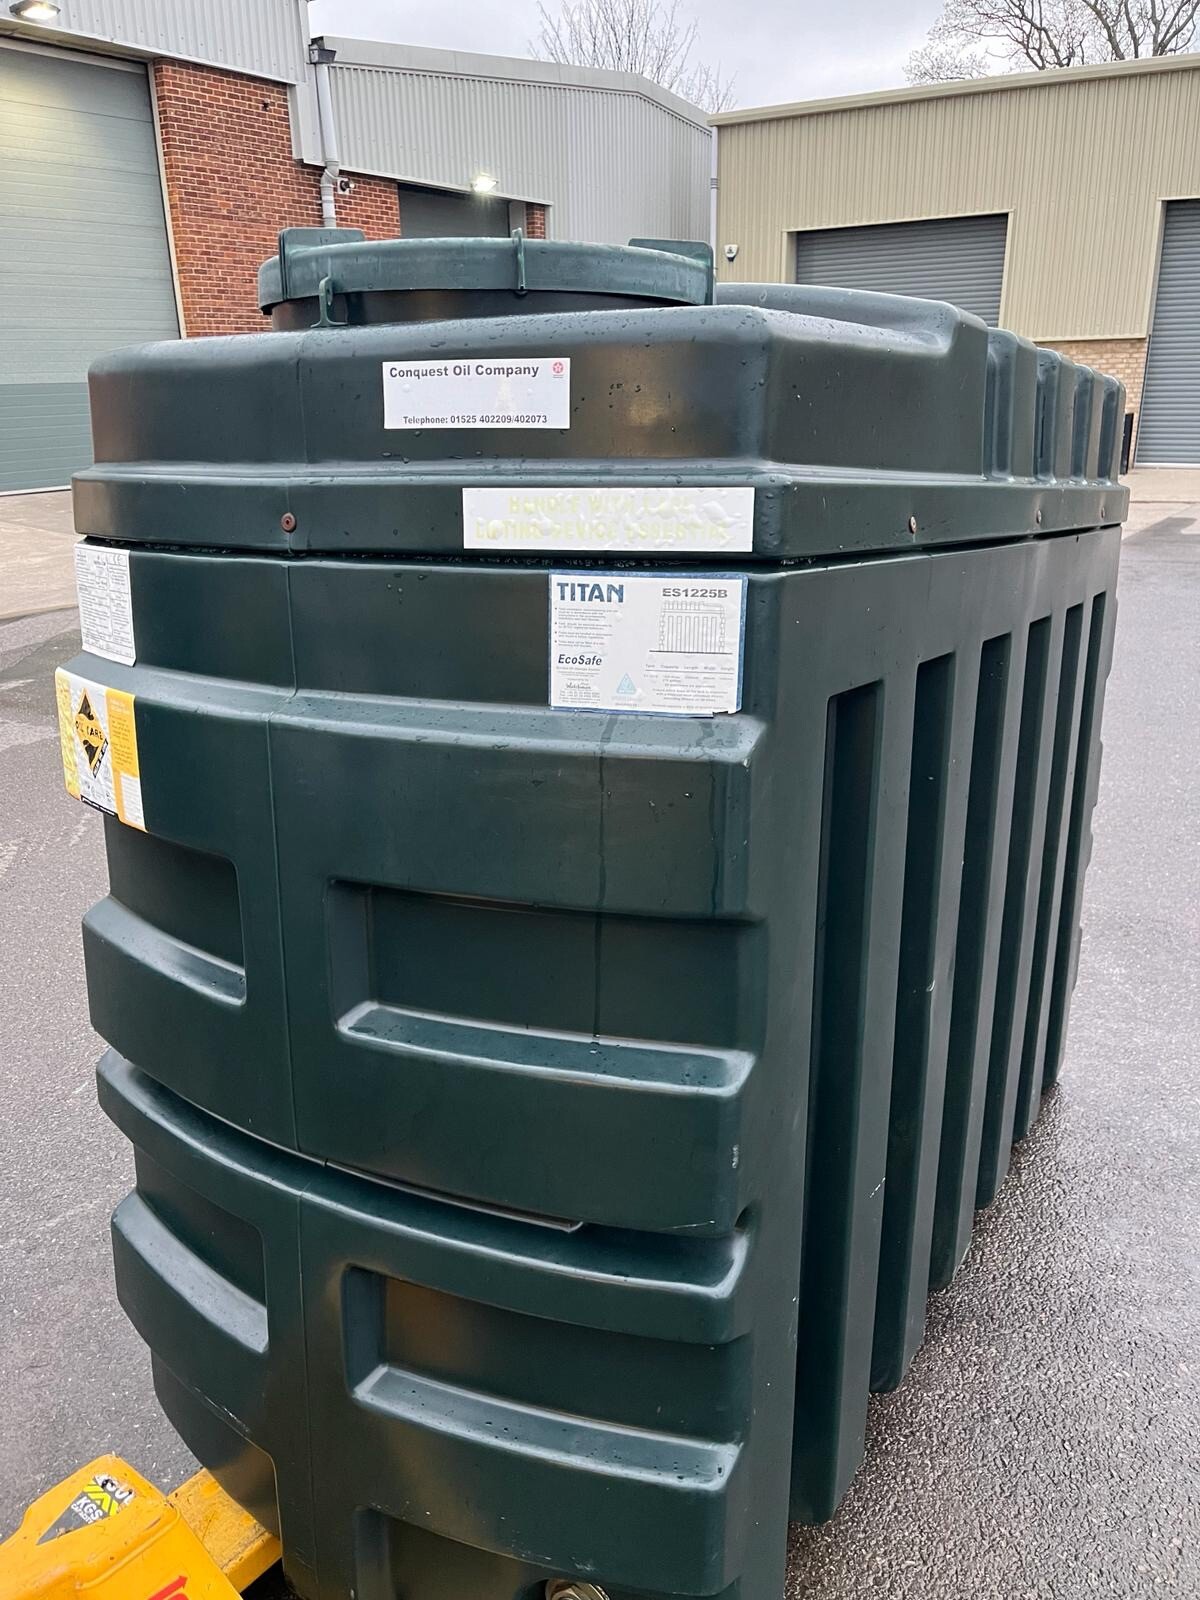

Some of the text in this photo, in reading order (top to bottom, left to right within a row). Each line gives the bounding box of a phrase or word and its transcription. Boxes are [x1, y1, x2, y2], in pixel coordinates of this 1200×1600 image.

[389, 364, 540, 380] Conquest Oil Company
[403, 416, 448, 426] Telephone:
[450, 415, 477, 424] 01525
[556, 582, 624, 603] TITAN
[662, 587, 728, 599] ES1225B
[558, 654, 602, 666] EcoSafe
[76, 1496, 103, 1520] KGS
